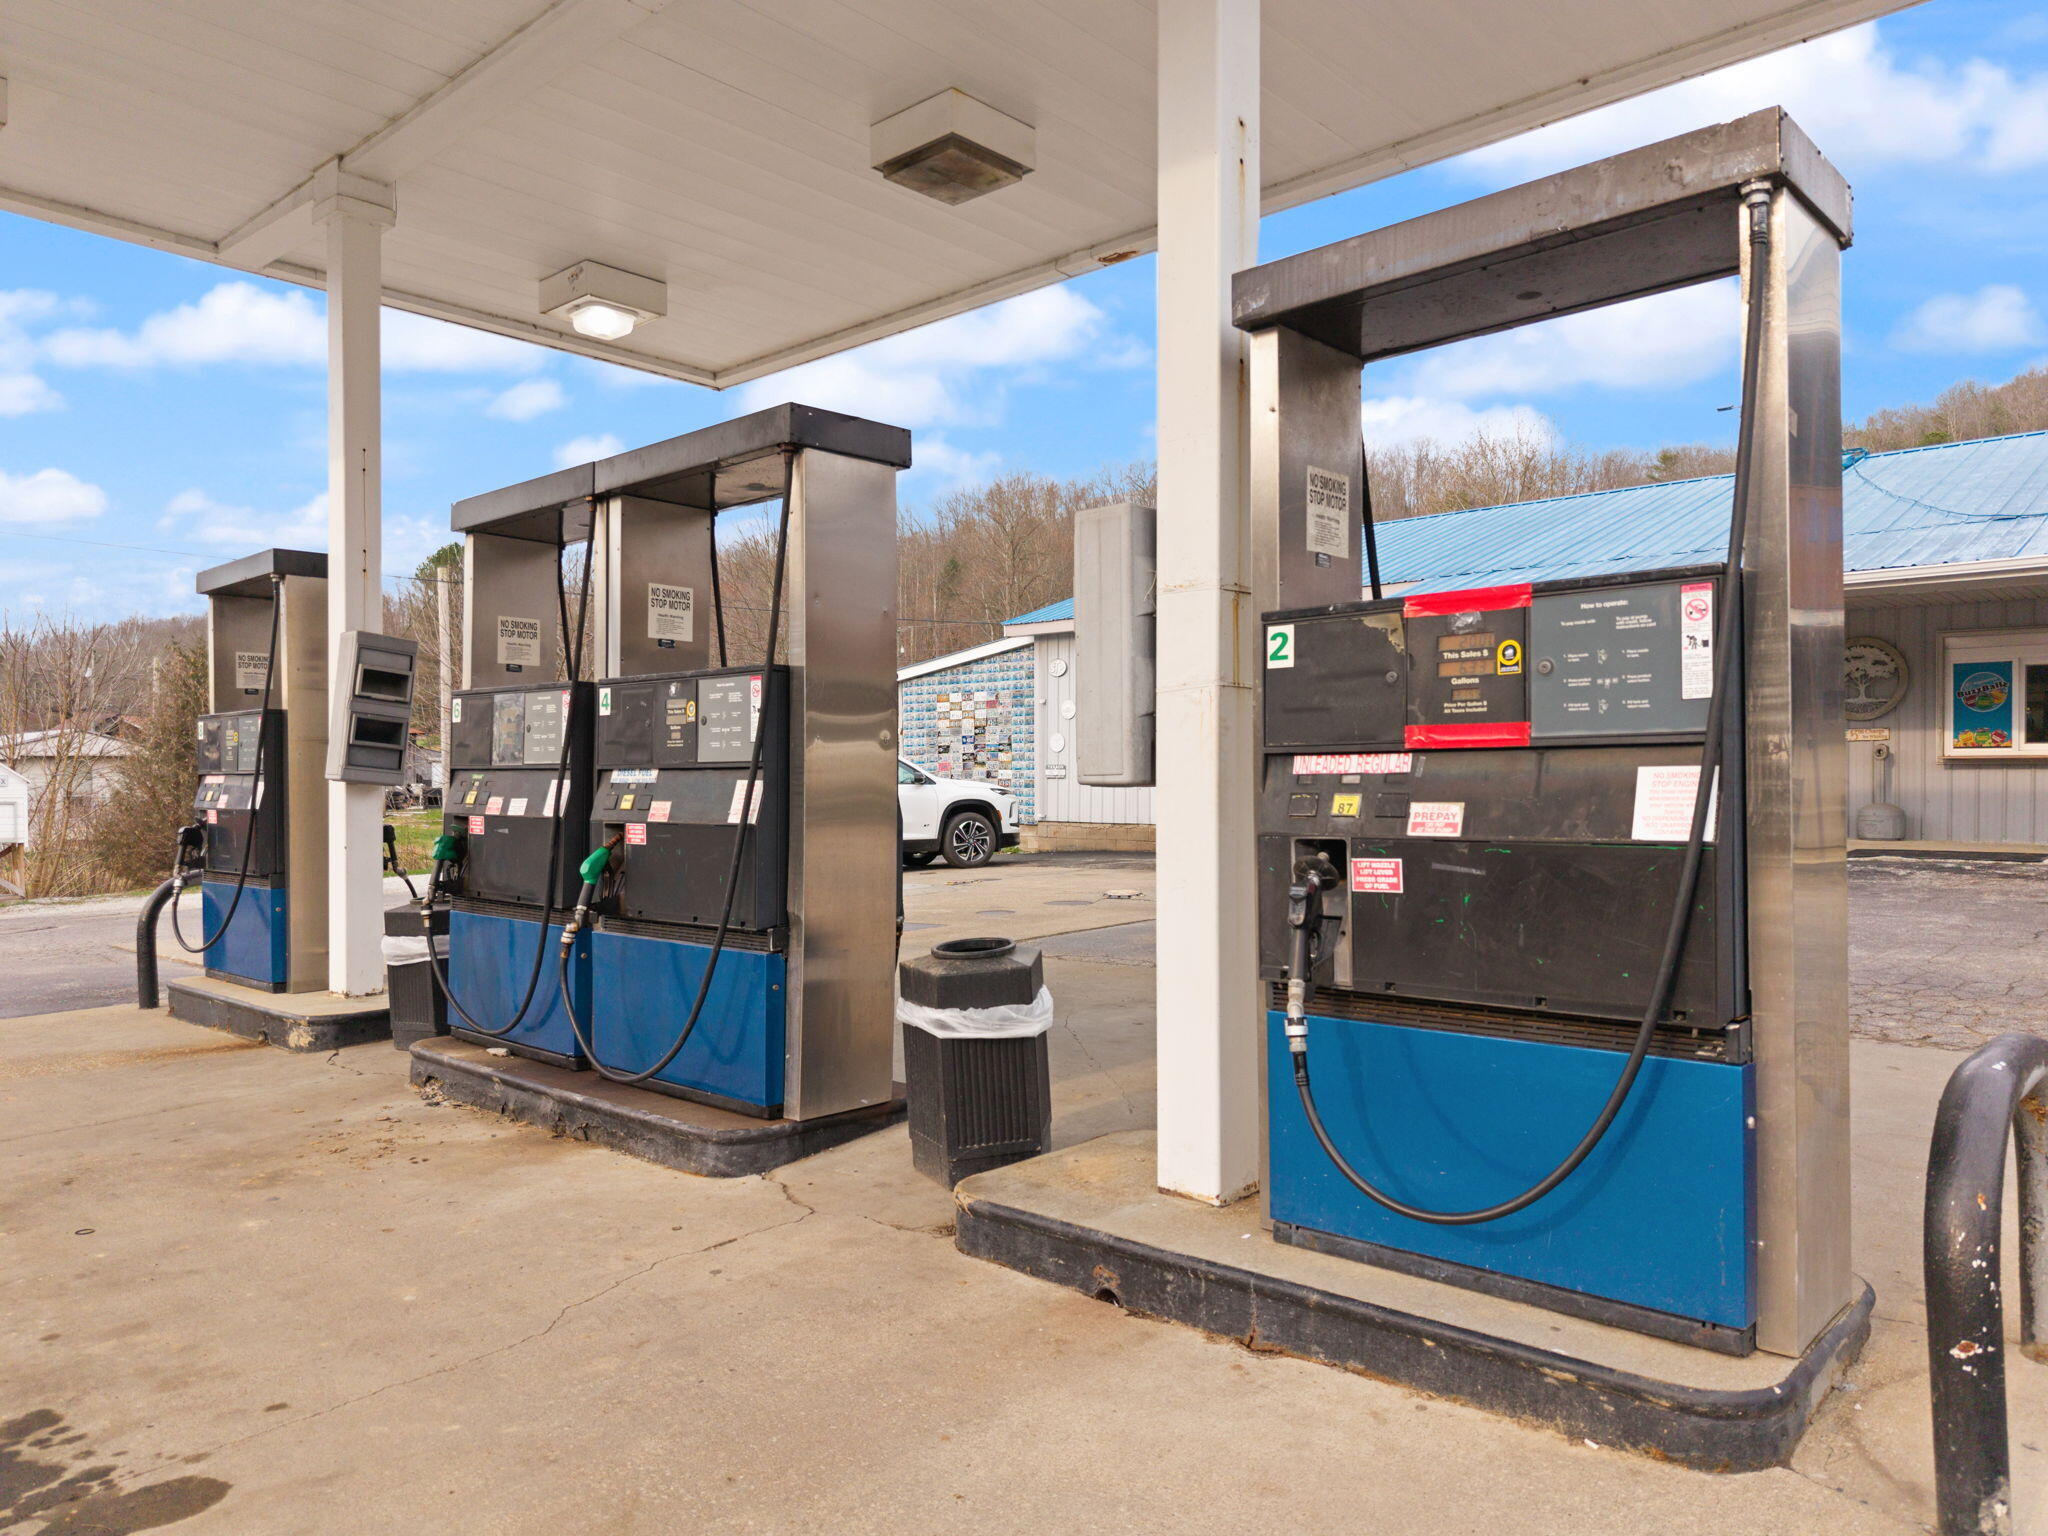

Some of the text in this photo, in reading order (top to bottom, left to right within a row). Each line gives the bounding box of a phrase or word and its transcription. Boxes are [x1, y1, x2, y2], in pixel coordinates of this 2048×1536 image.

[1309, 473, 1346, 496] NO SMOKING
[1309, 489, 1347, 512] STOP MOTOR
[651, 587, 691, 601] NO SMOKING
[651, 598, 691, 611] STOP MOTOR
[500, 619, 538, 631] NO SMOKING
[500, 629, 538, 640] STOP MOTOR
[1269, 632, 1289, 661] 2
[1460, 650, 1481, 658] Sales
[253, 662, 268, 670] MOTO
[1451, 677, 1480, 685] Gallons
[601, 692, 609, 711] 4
[454, 702, 460, 719] 6
[1294, 753, 1412, 774] UNLEADED REGULAR
[1666, 771, 1701, 779] SMOKIN
[1338, 803, 1353, 814] 87
[1413, 812, 1457, 821] PREPAY
